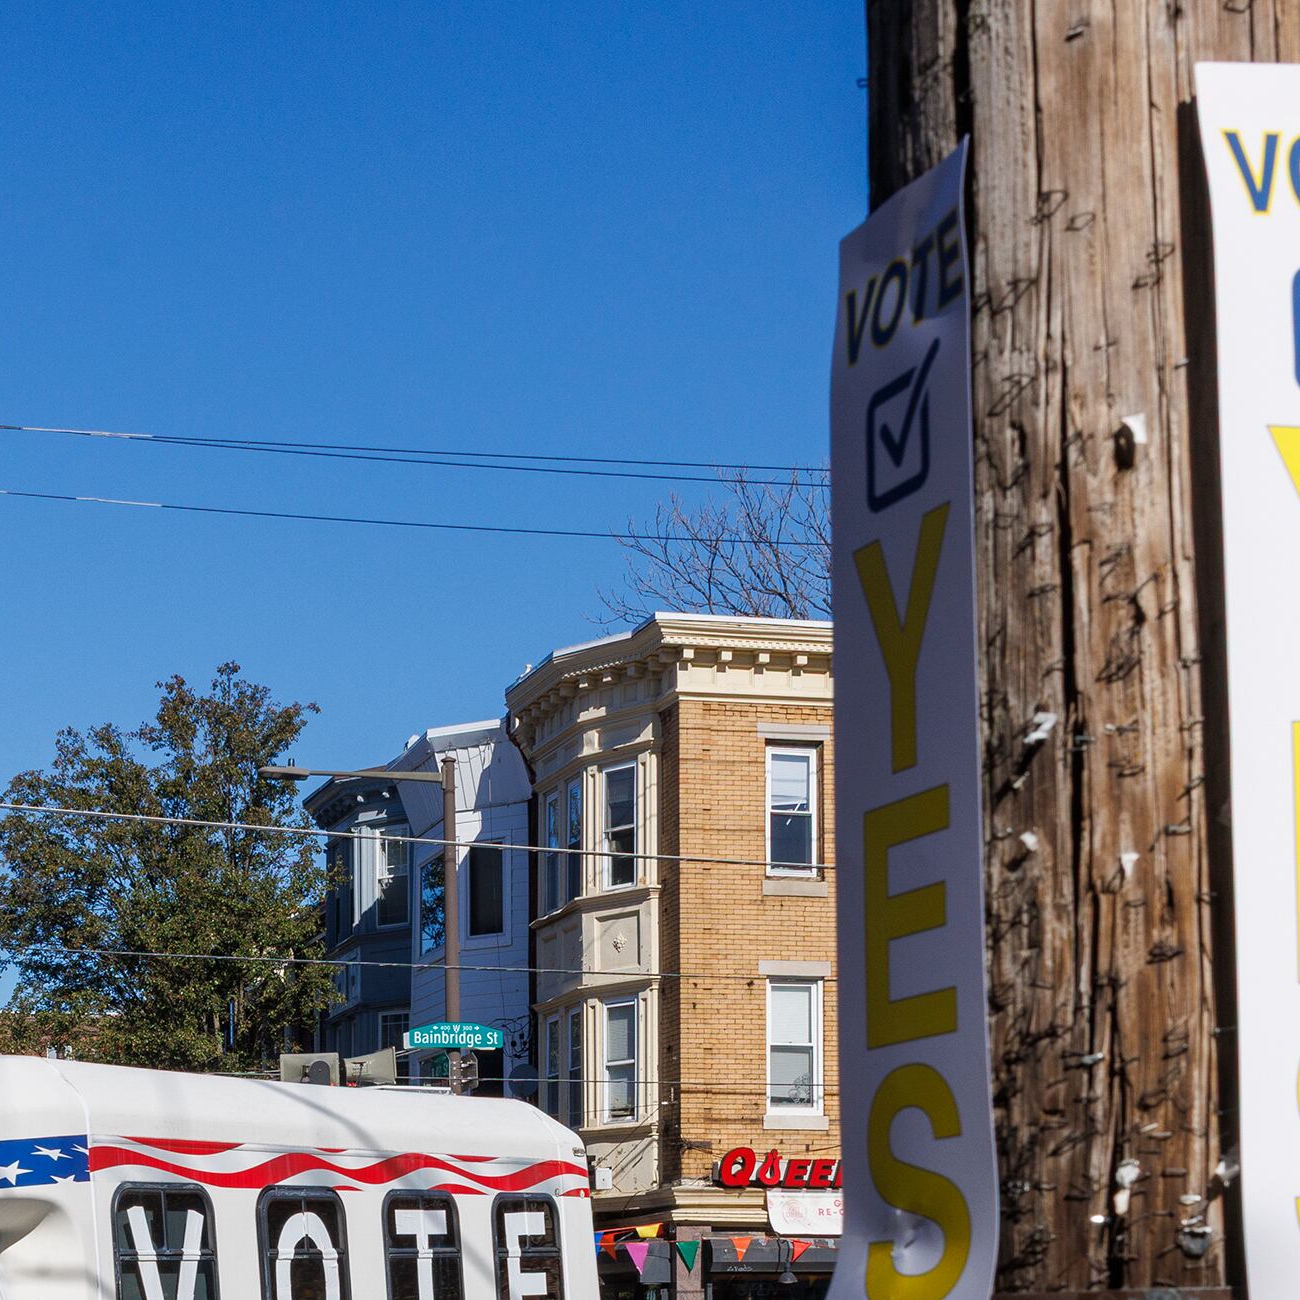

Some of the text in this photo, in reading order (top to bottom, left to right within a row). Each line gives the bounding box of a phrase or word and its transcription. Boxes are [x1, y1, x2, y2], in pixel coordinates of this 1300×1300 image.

[844, 206, 964, 368] VOTE
[414, 1030, 498, 1047] Bainbridge St
